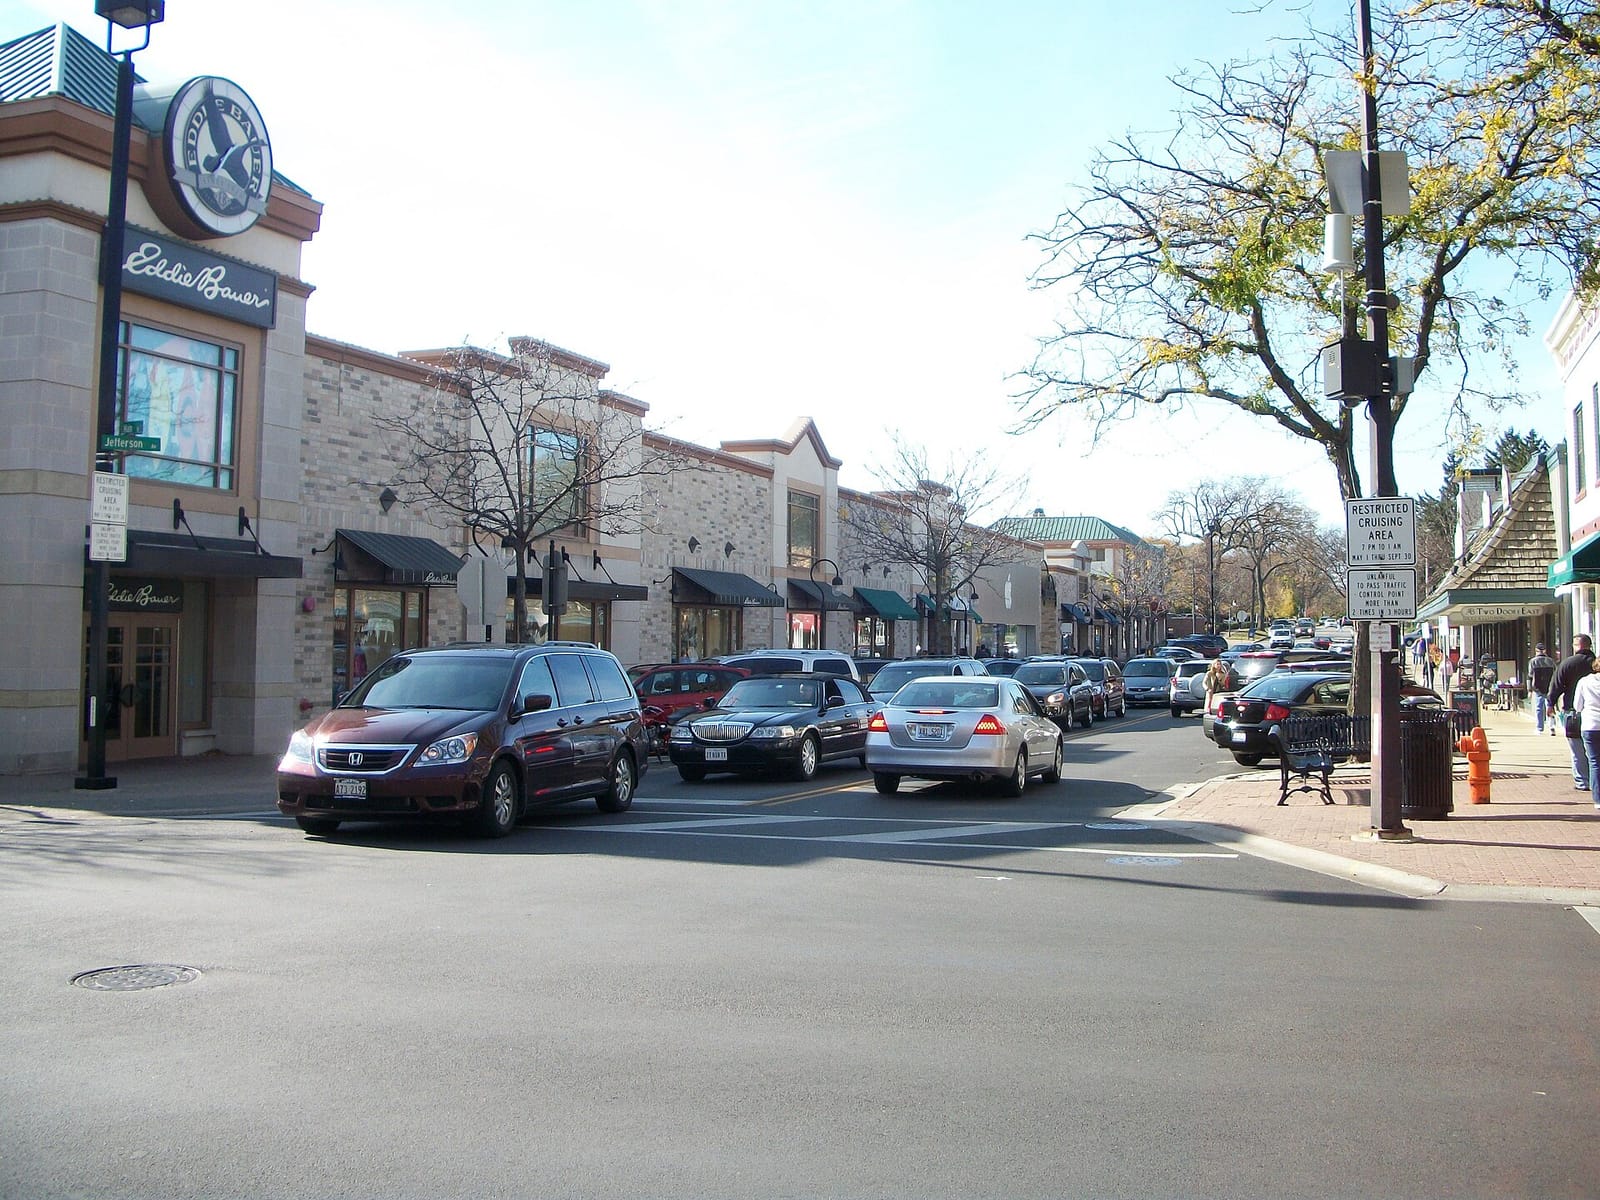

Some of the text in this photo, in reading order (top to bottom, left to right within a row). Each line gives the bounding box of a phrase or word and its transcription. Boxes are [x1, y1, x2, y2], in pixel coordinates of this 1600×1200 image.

[122, 242, 270, 309] Eddie Bauer
[104, 437, 144, 449] Jefferson
[1352, 503, 1409, 515] RESTRICTED
[1358, 516, 1403, 528] CRUISING
[1368, 530, 1394, 541] AREA
[1367, 543, 1376, 551] PM
[1378, 543, 1386, 551] TO
[1388, 552, 1401, 561] SEPT
[1404, 552, 1412, 560] 30
[1383, 581, 1407, 589] TRAFFIC
[135, 585, 180, 606] Bauer
[1358, 590, 1405, 598] CONTROL POINT
[1365, 599, 1399, 607] MORE THAN
[1359, 608, 1375, 616] TIMES
[1393, 608, 1412, 616] HOURS
